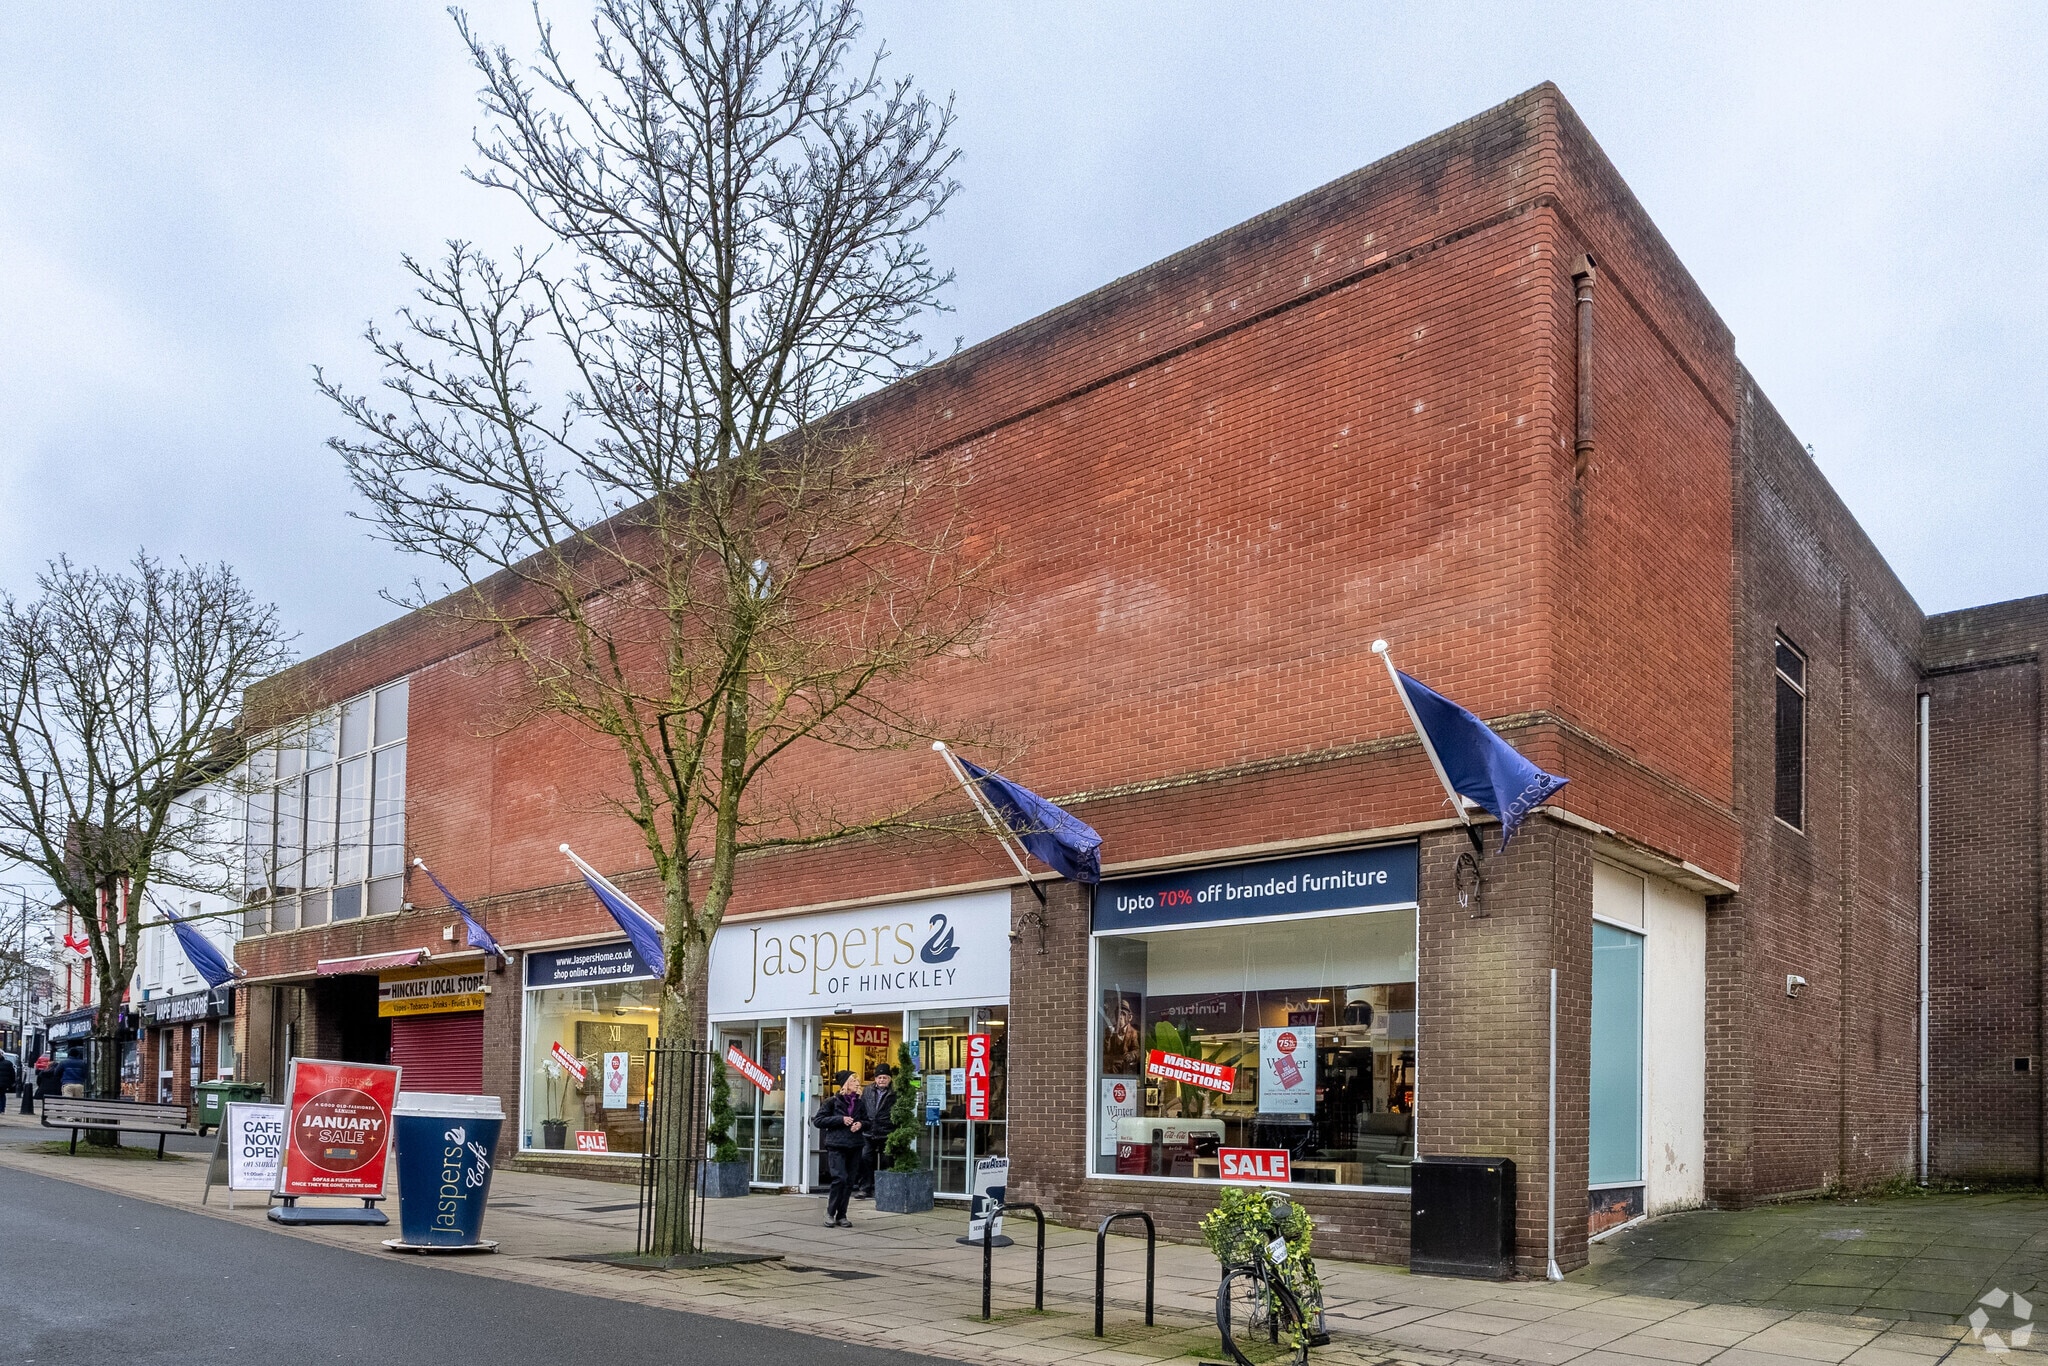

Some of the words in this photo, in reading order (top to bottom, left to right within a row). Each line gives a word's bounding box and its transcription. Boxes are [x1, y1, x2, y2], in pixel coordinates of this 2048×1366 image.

[1117, 894, 1154, 914] Upto
[1159, 888, 1193, 908] 70%
[1197, 884, 1222, 904] off
[1226, 876, 1297, 901] branded
[1302, 868, 1388, 892] furniture
[556, 948, 633, 966] www.JaspersHome.co.uk
[744, 922, 915, 1004] Jaspers
[554, 968, 569, 979] shop
[569, 966, 588, 978] online
[589, 966, 597, 976] 24
[598, 964, 616, 975] hours
[622, 962, 634, 974] day
[828, 976, 850, 994] OF
[860, 968, 957, 992] HINCKLEY
[392, 980, 429, 999] HINCKLEY
[431, 977, 455, 995] LOCAL
[156, 1004, 171, 1021] VAPE
[171, 996, 209, 1018] MEGASTORE
[433, 1001, 448, 1009] Drinks
[452, 999, 466, 1008] Fruits
[472, 998, 482, 1007] Veg
[856, 1028, 889, 1046] SALE
[728, 1049, 747, 1070] HUGE
[744, 1062, 773, 1091] SAVINGS
[1164, 1054, 1222, 1076] MASSIVE
[324, 1074, 365, 1088] Jaspers
[969, 1038, 987, 1117] SALE
[1149, 1062, 1232, 1092] REDUCTIONS
[1106, 1106, 1134, 1117] Winter
[244, 1121, 282, 1134] CAFE
[302, 1115, 383, 1131] JANUARY
[245, 1134, 282, 1146] NOW
[319, 1130, 365, 1145] SALE
[578, 1135, 606, 1150] SALE
[466, 1141, 489, 1189] Café
[1223, 1154, 1285, 1178] SALE
[430, 1146, 466, 1236] Jaspers
